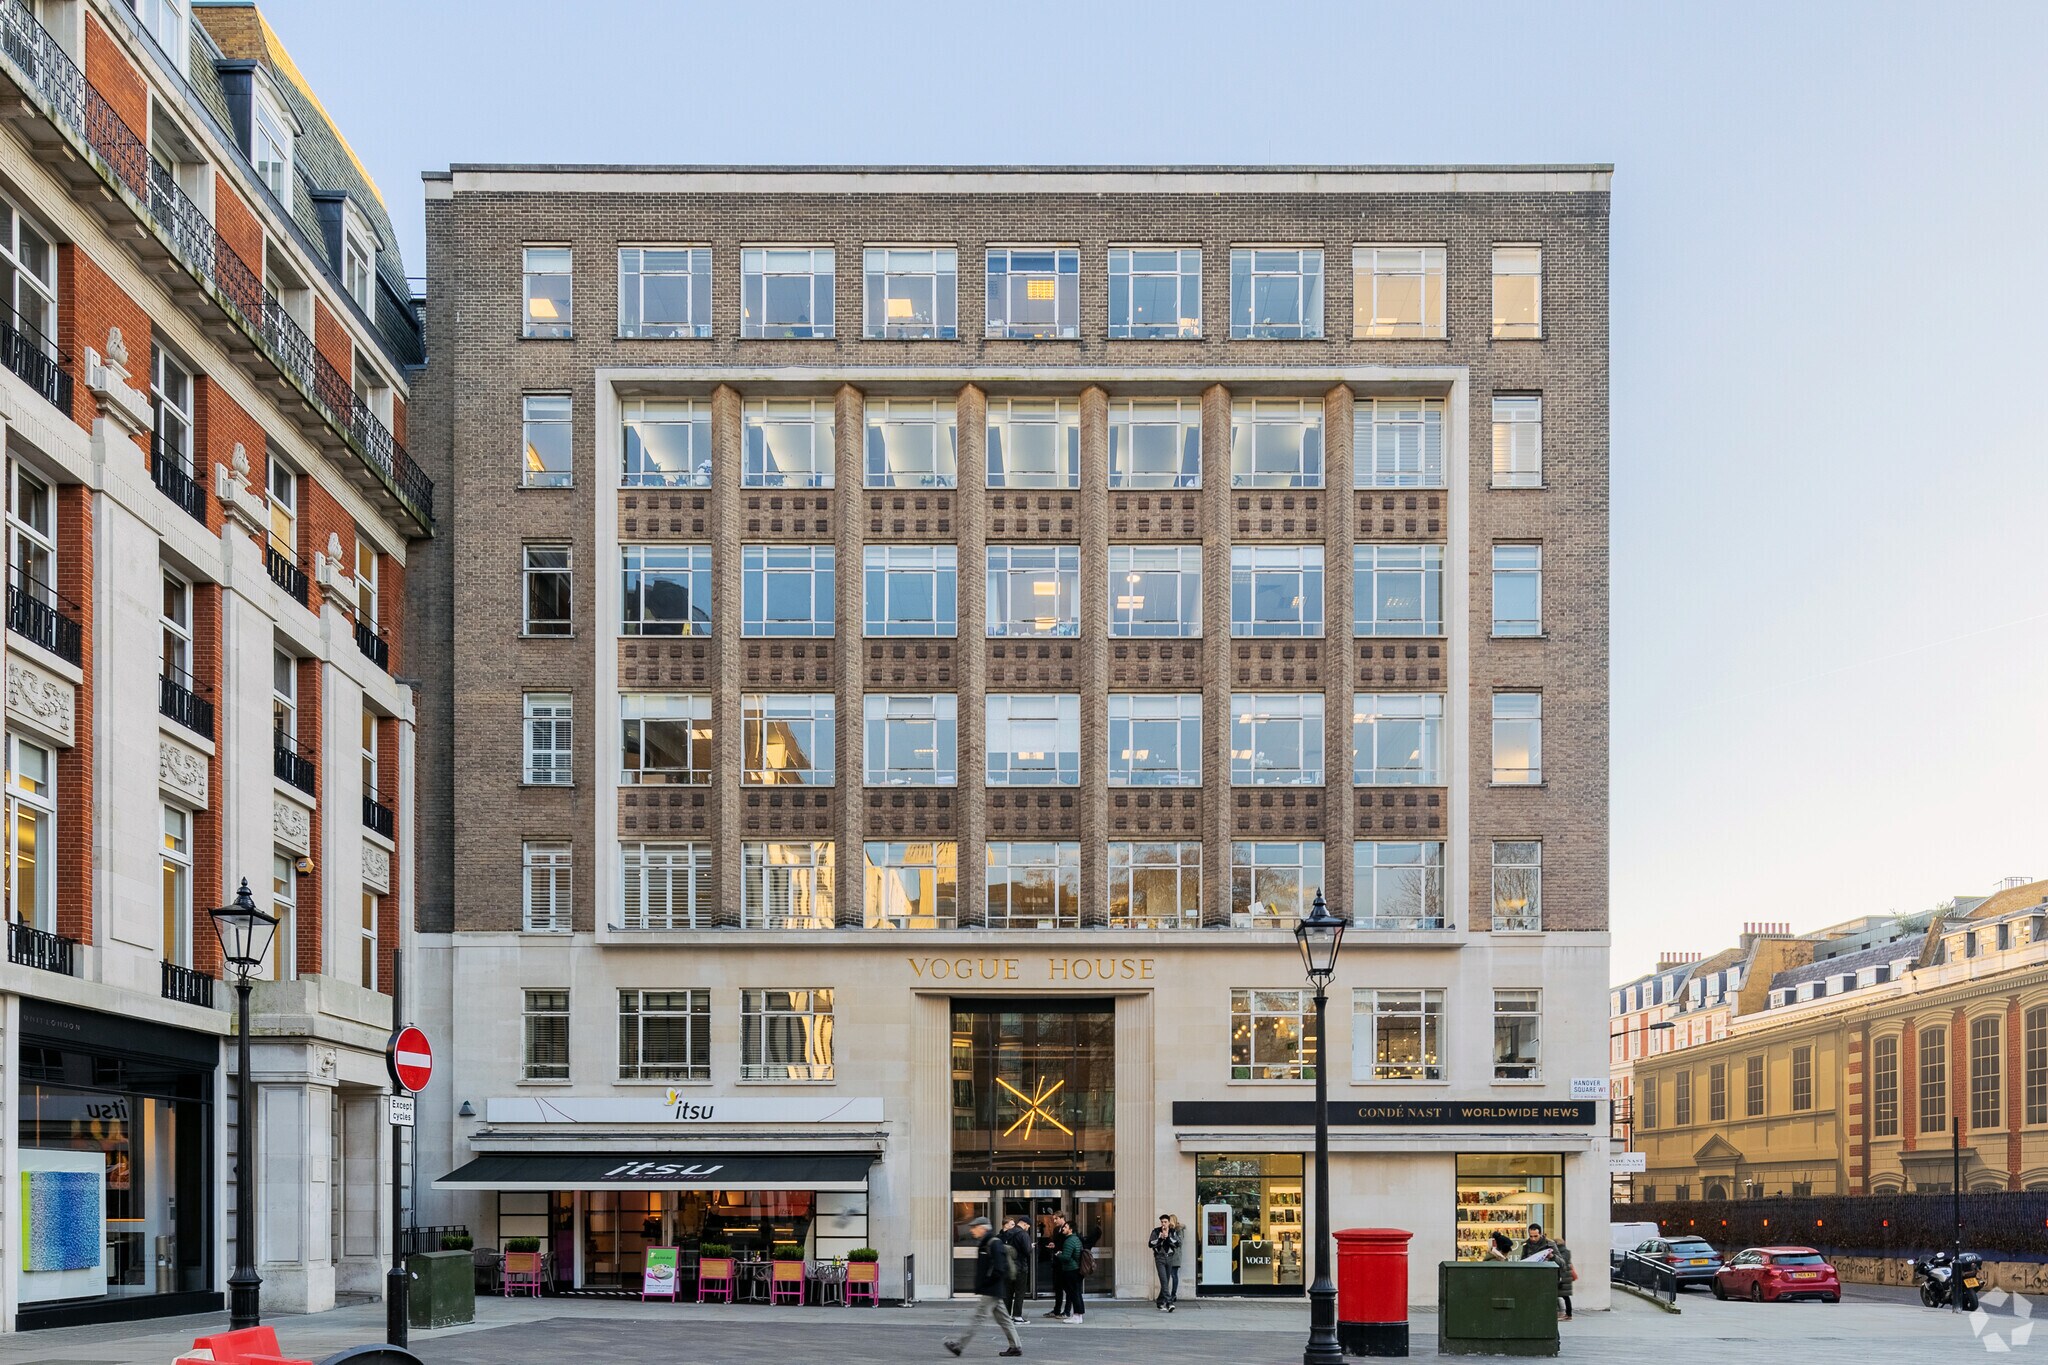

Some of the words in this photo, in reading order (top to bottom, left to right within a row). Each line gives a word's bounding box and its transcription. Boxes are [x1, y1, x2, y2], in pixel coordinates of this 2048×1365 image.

[907, 958, 1020, 980] VOGUE
[1048, 958, 1156, 980] HOUSE
[46, 1019, 81, 1031] LONDON
[392, 1099, 412, 1111] Except
[675, 1100, 714, 1120] itsu
[1358, 1104, 1405, 1118] CONDÉ
[1407, 1107, 1442, 1118] NAST
[1461, 1108, 1539, 1117] WORLDWIDE
[1543, 1108, 1579, 1117] NEWS
[393, 1112, 411, 1121] cycles
[604, 1161, 724, 1176] itsu
[980, 1175, 1030, 1186] VOGUE
[1038, 1175, 1086, 1186] HOUSE
[1245, 1256, 1271, 1265] VOGUE
[1889, 1263, 1909, 1279] the
